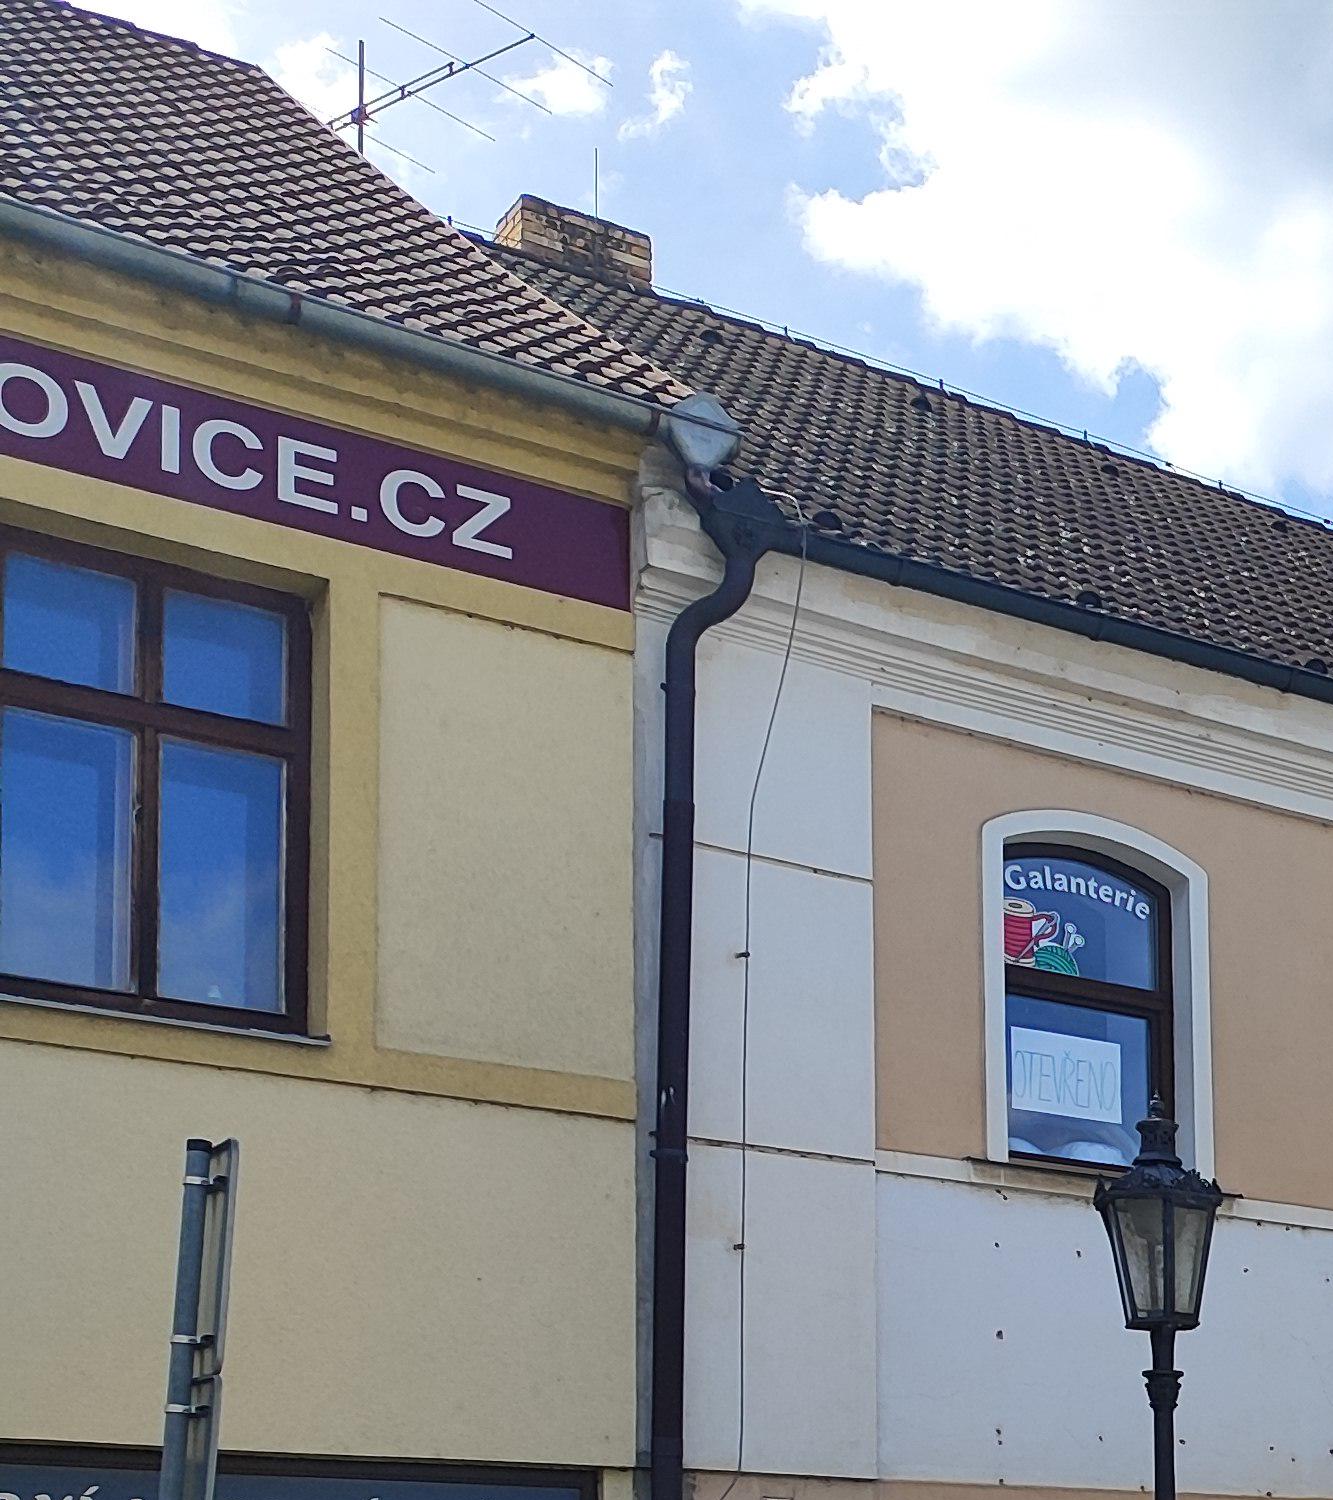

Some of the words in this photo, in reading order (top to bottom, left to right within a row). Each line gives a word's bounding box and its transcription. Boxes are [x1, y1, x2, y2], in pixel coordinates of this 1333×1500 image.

[0, 362, 513, 560] OVICE.CZ
[1004, 865, 1150, 920] Galanterie
[1014, 1050, 1117, 1112] OTEVŘENO
